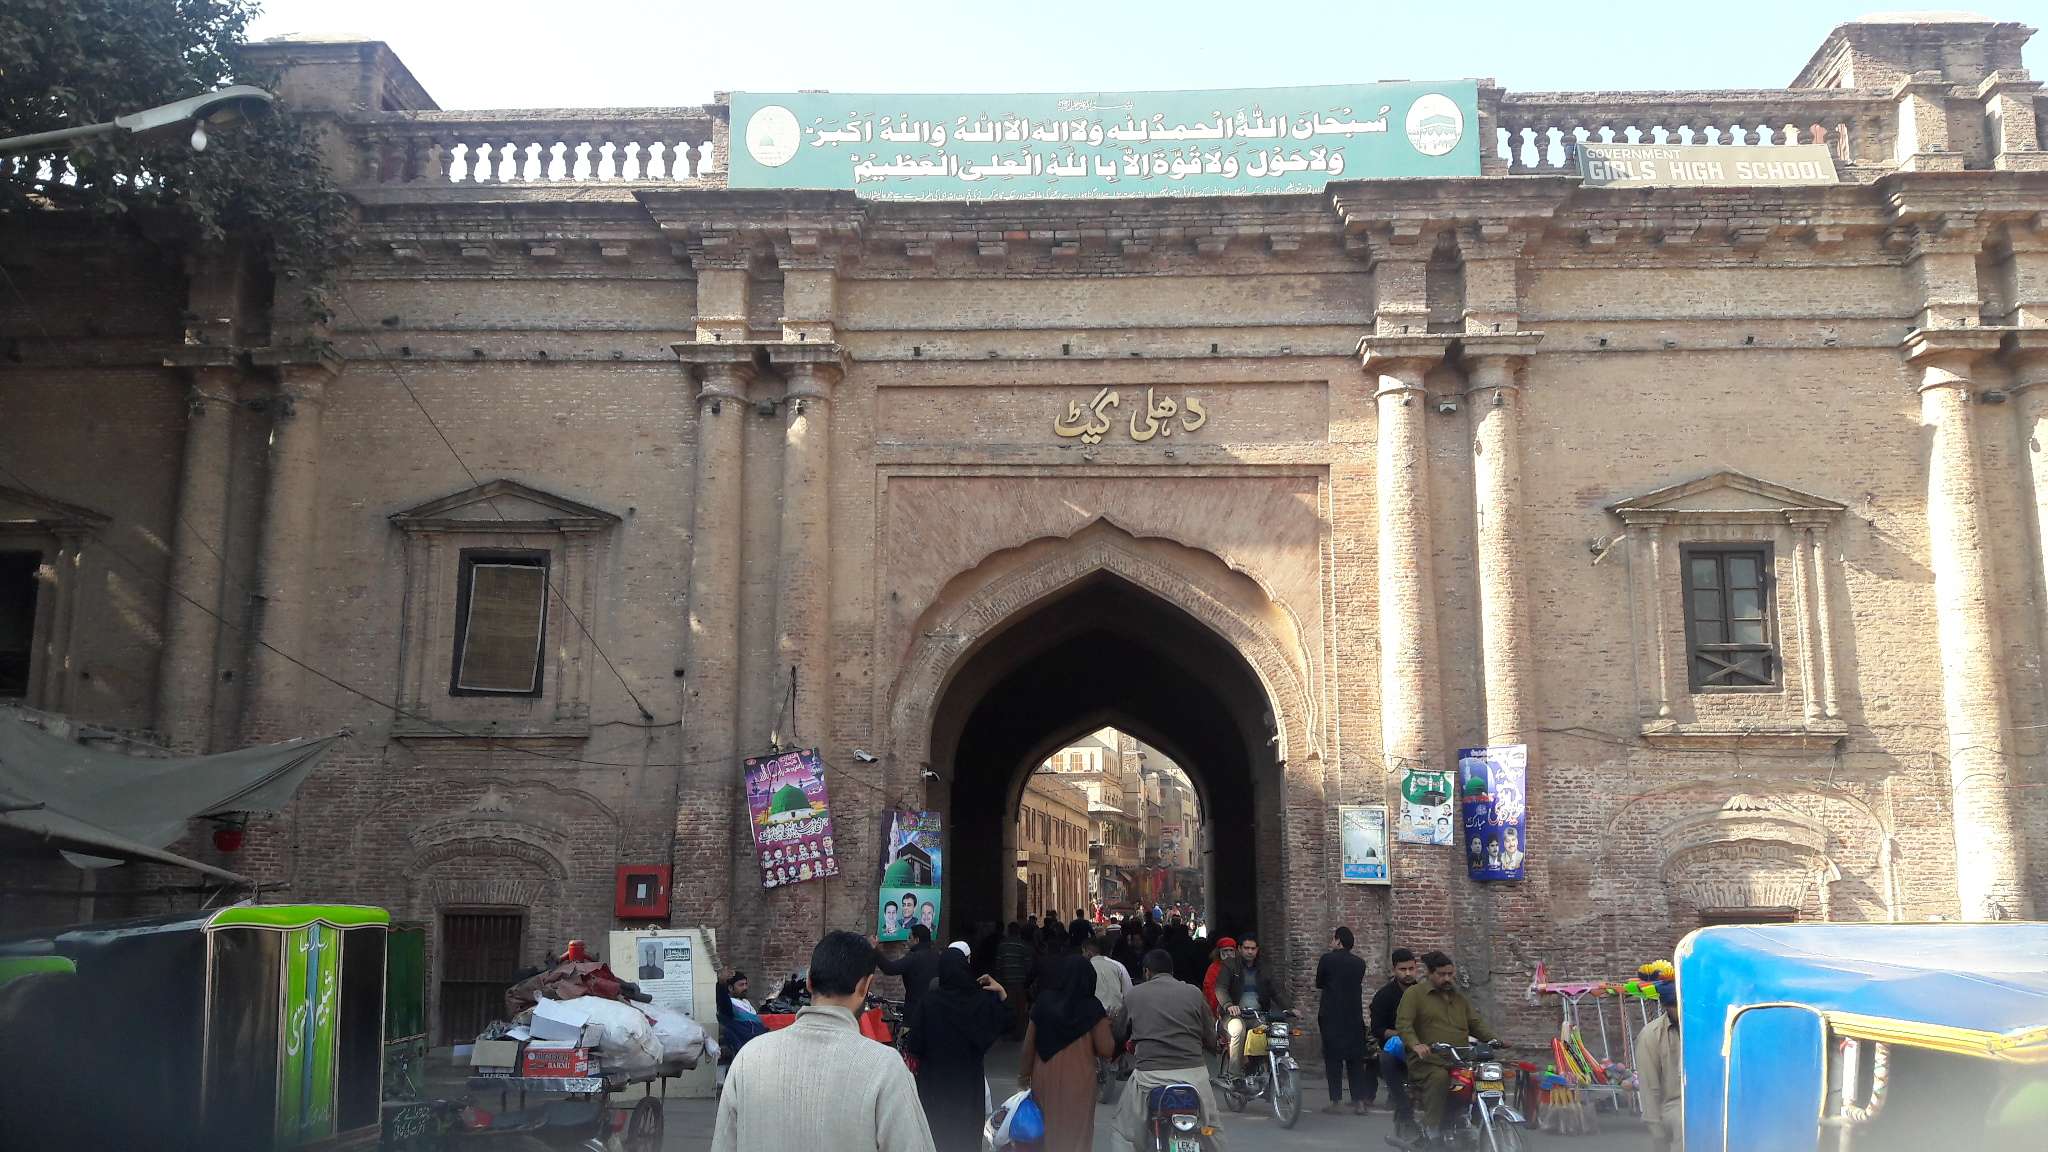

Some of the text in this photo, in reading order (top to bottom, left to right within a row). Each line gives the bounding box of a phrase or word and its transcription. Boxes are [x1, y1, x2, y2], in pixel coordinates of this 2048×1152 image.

[1586, 149, 1681, 160] GOVERNMENT
[1588, 161, 1831, 181] GIRLS HIGH SCHOOL
[1054, 387, 1120, 445] گیٹ
